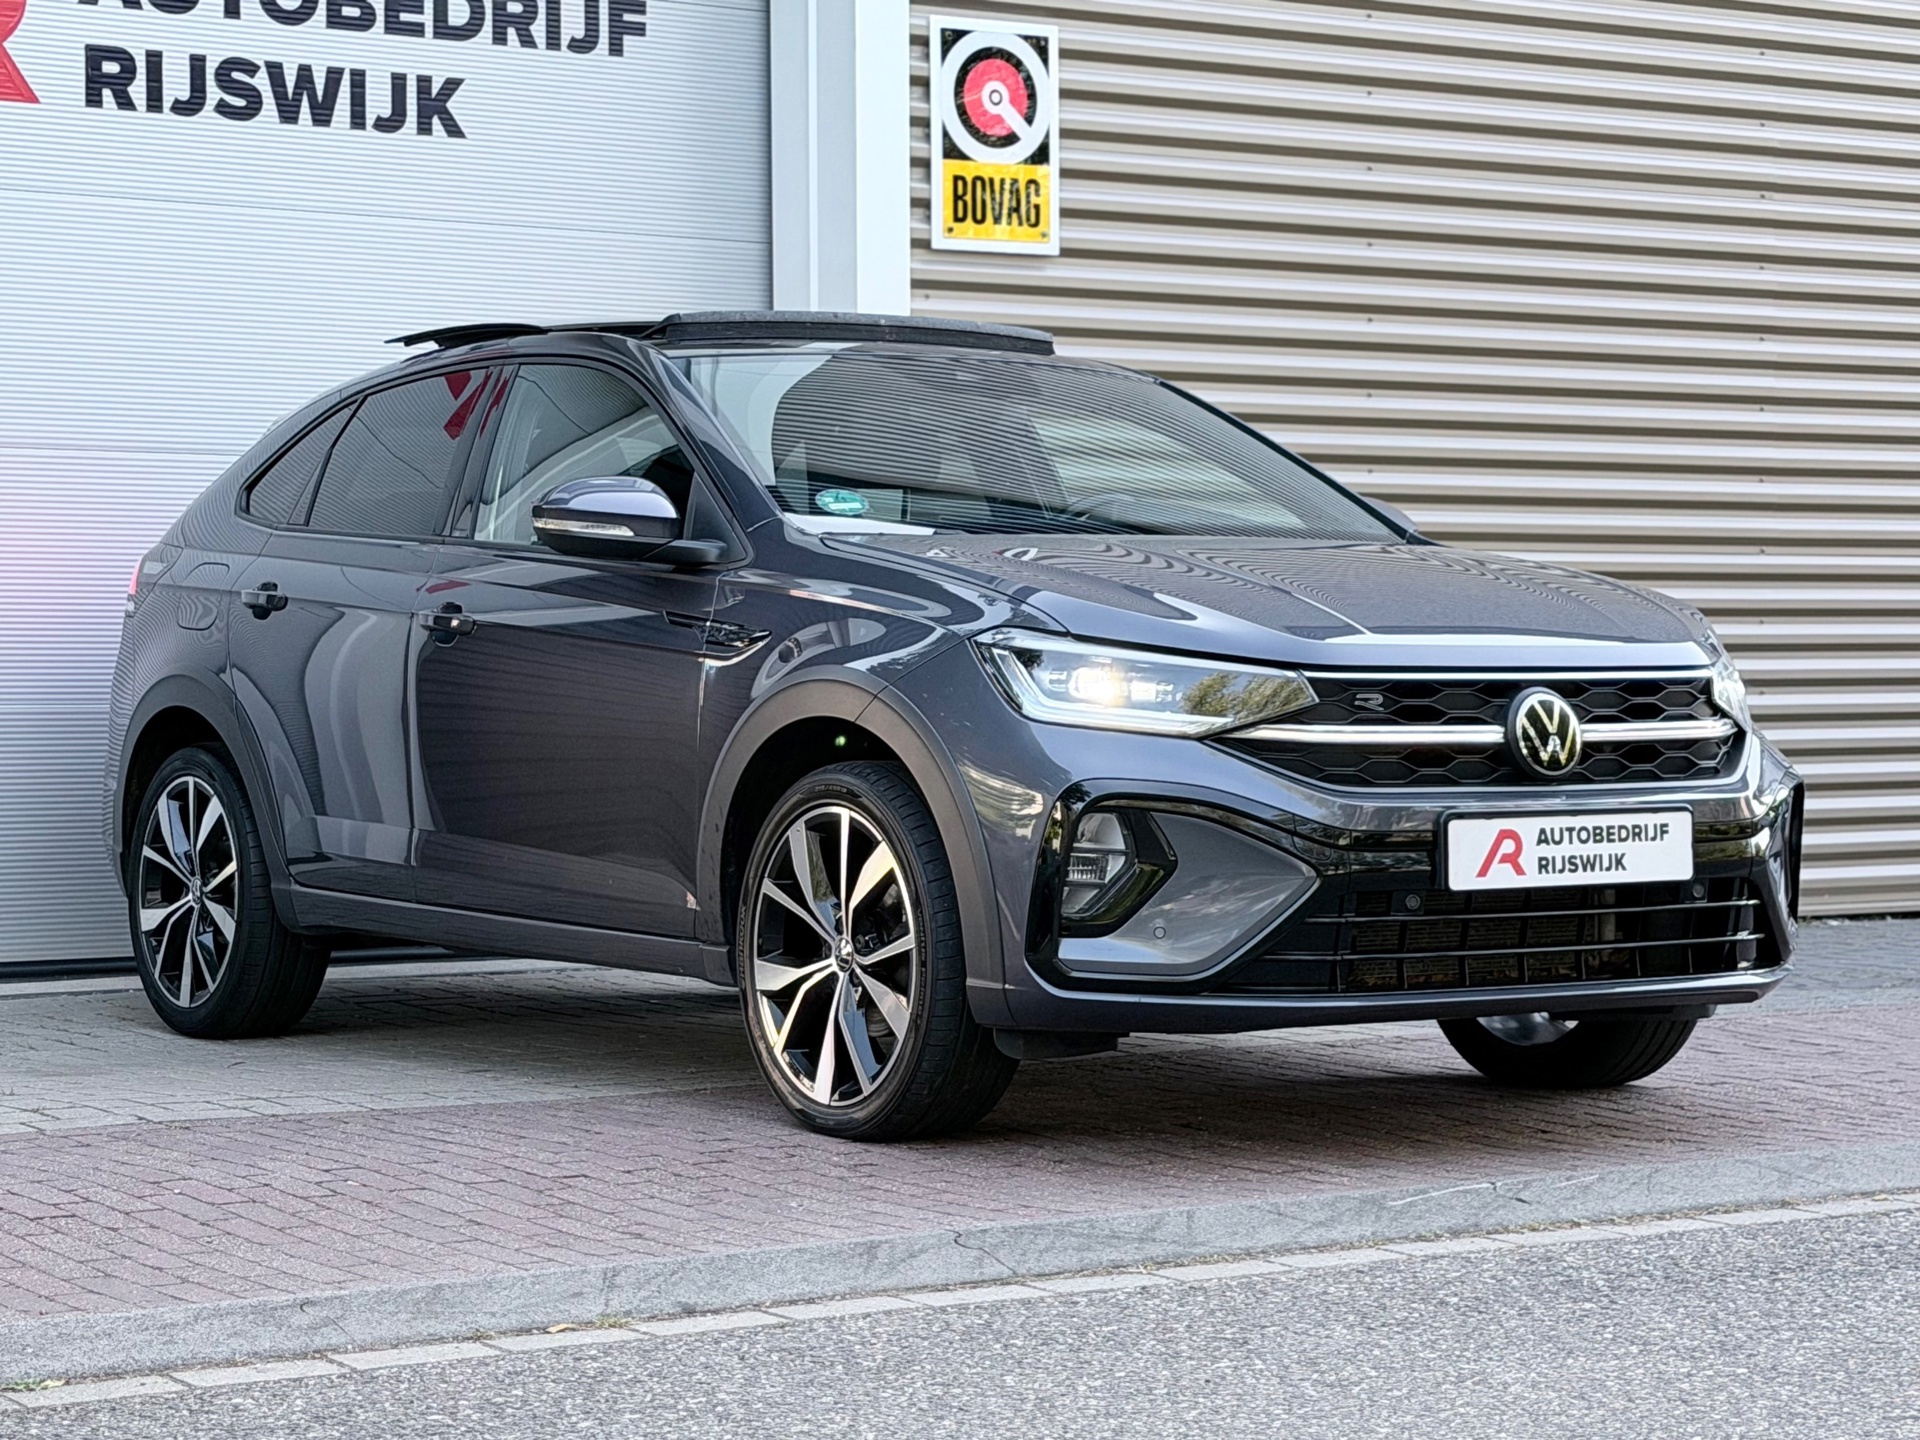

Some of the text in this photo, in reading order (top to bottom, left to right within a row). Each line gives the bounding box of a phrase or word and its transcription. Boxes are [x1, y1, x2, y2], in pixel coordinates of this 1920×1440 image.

[77, 0, 647, 57] BEDRIJF
[85, 44, 468, 139] RIJSWIJK
[952, 175, 1041, 228] BOVAG
[1536, 823, 1670, 846] AUTOBEDRIJF
[1537, 853, 1627, 875] RIJSWIJK
